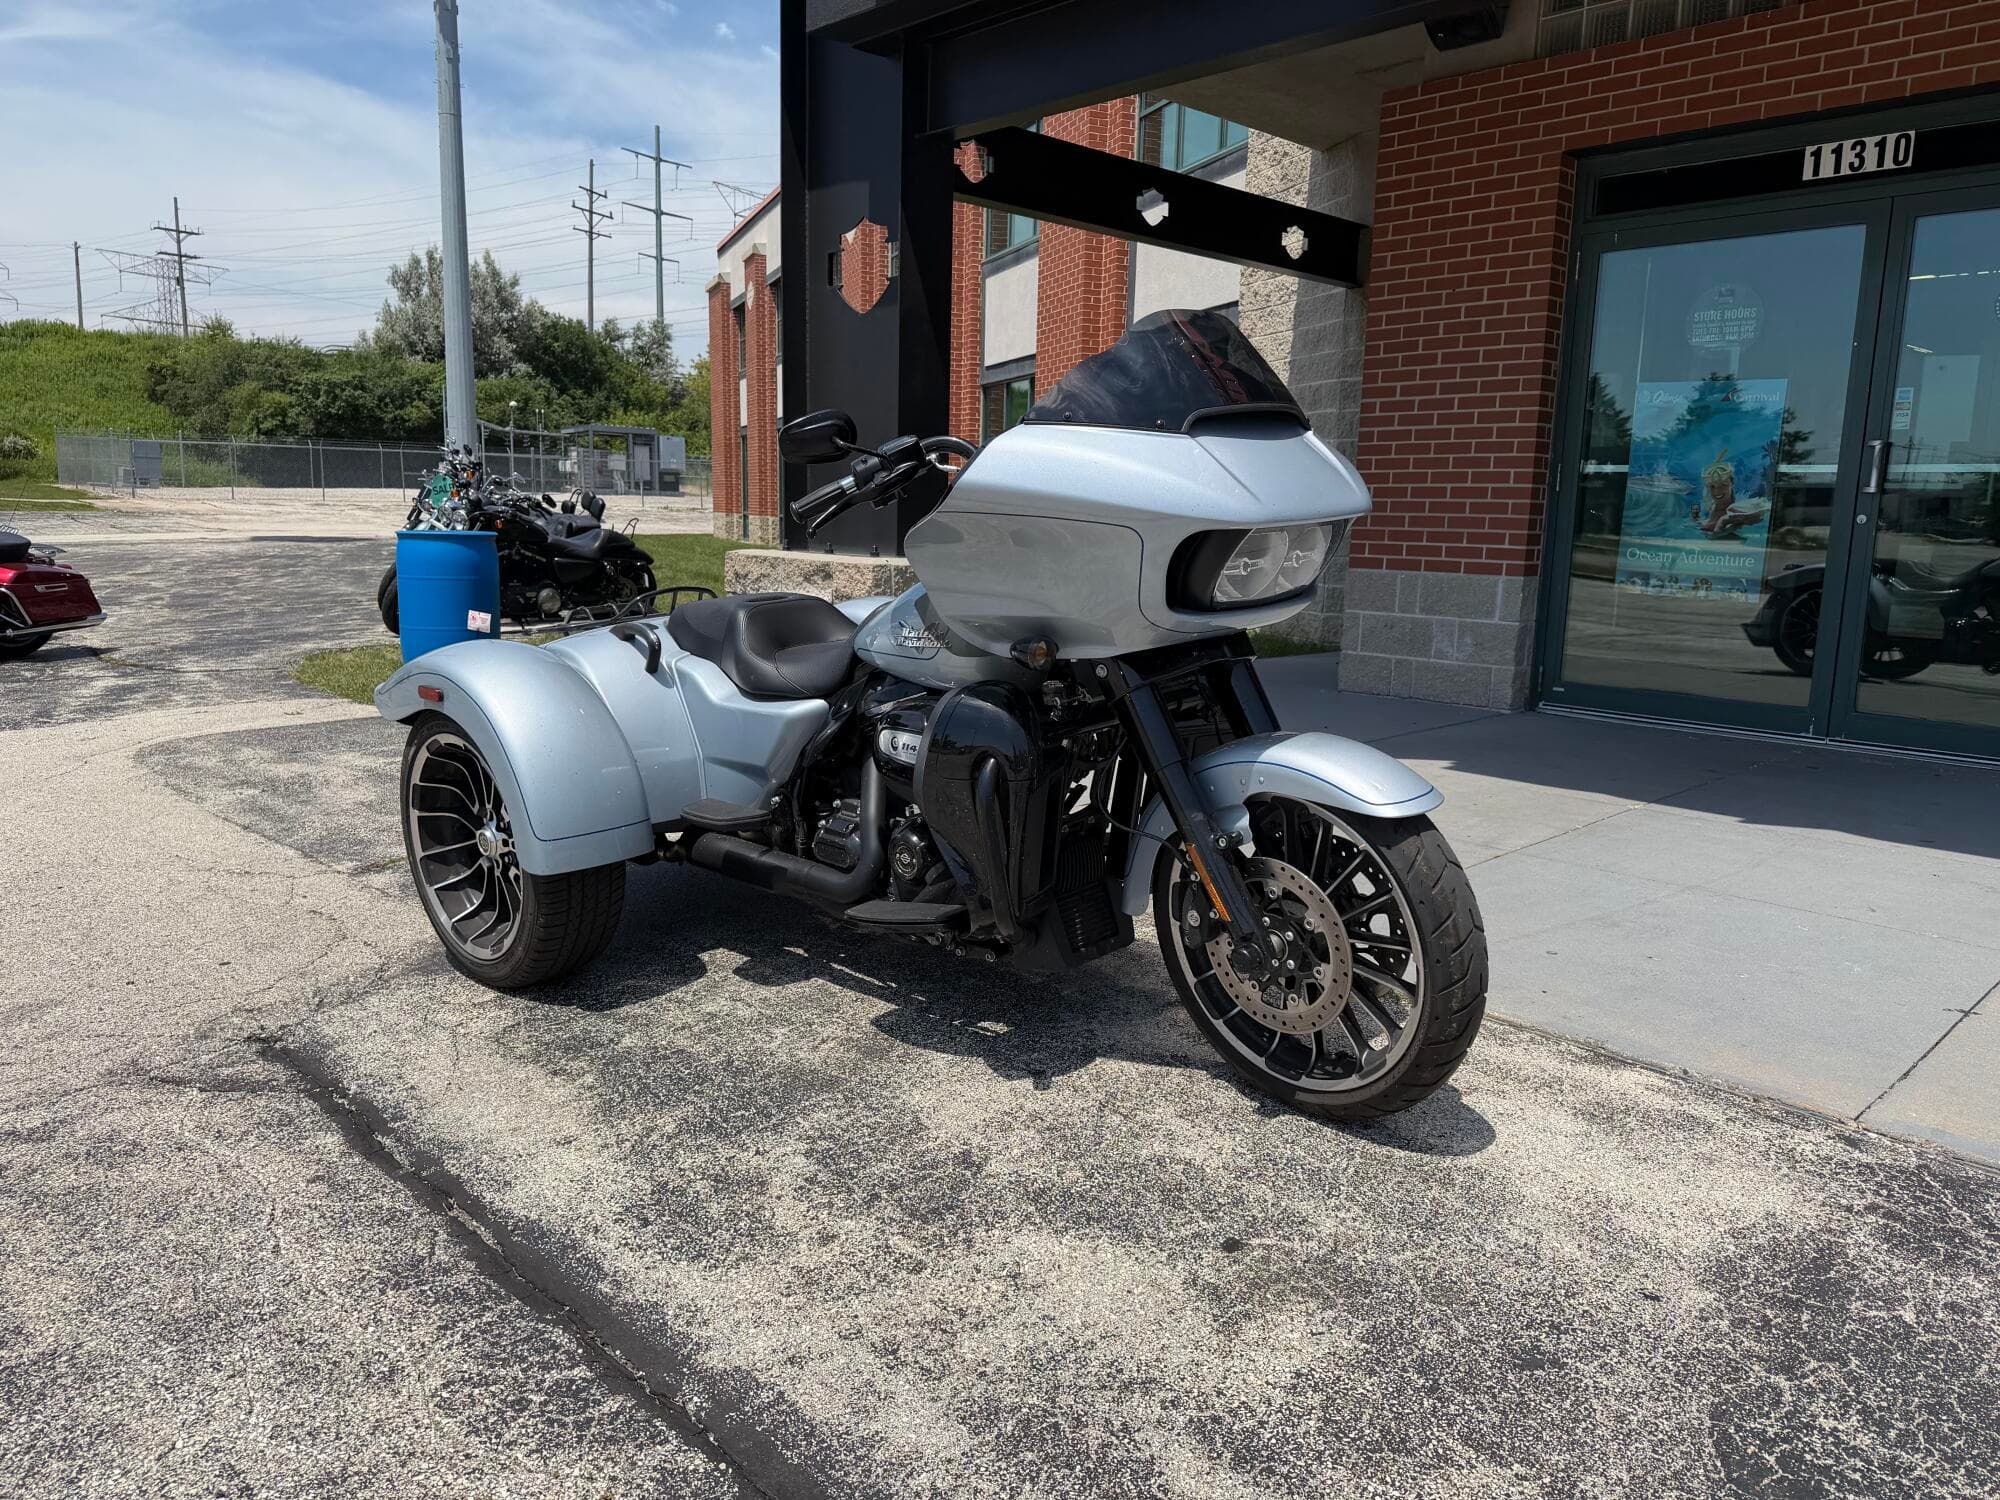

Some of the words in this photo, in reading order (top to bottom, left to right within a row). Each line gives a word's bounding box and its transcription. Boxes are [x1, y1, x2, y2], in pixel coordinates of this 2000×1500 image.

[1810, 133, 1912, 178] 11310
[1694, 310, 1722, 321] STORE
[1724, 307, 1757, 319] HOURS
[1733, 391, 1780, 402] Carnival
[1626, 547, 1672, 562] Ocean
[1677, 550, 1755, 568] Adventure
[902, 742, 918, 752] 114
